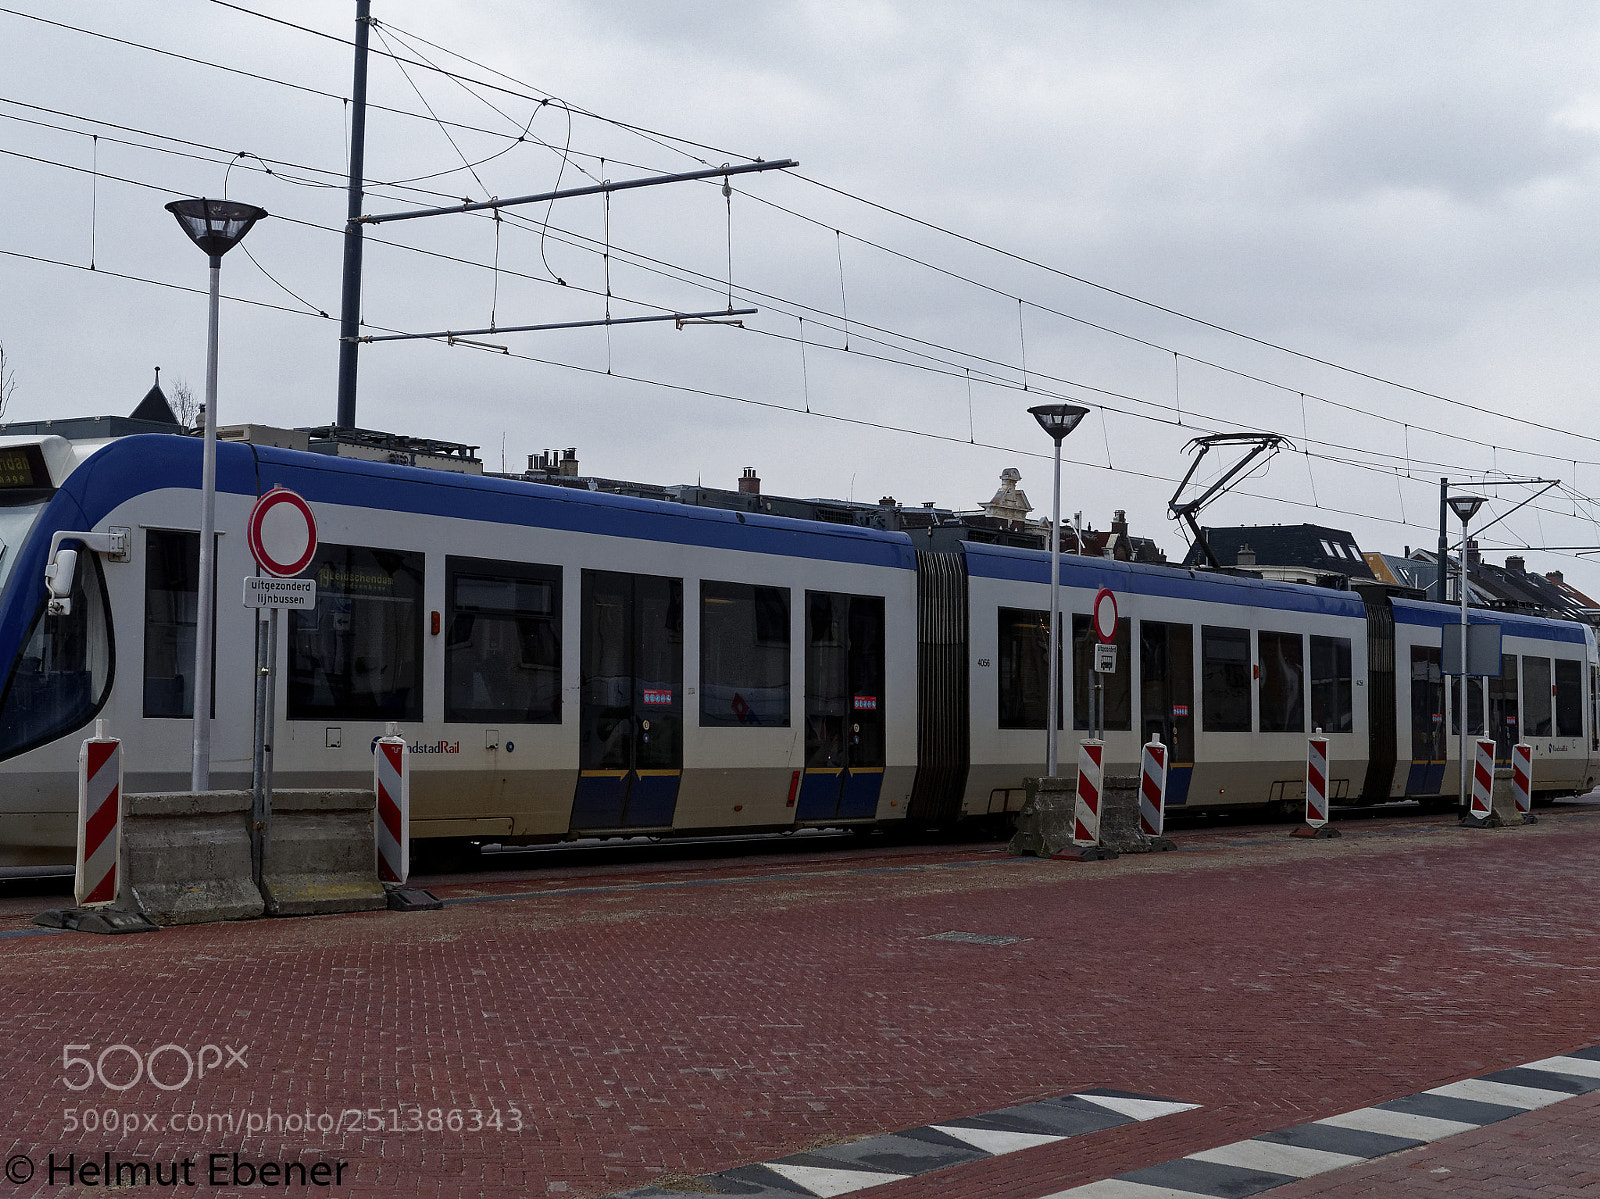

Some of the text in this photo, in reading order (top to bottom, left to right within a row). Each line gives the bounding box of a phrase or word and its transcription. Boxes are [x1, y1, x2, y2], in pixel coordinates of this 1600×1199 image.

[251, 580, 311, 592] uitgezonderd
[257, 593, 305, 605] lijnbussen
[406, 740, 460, 754] ndstadRail
